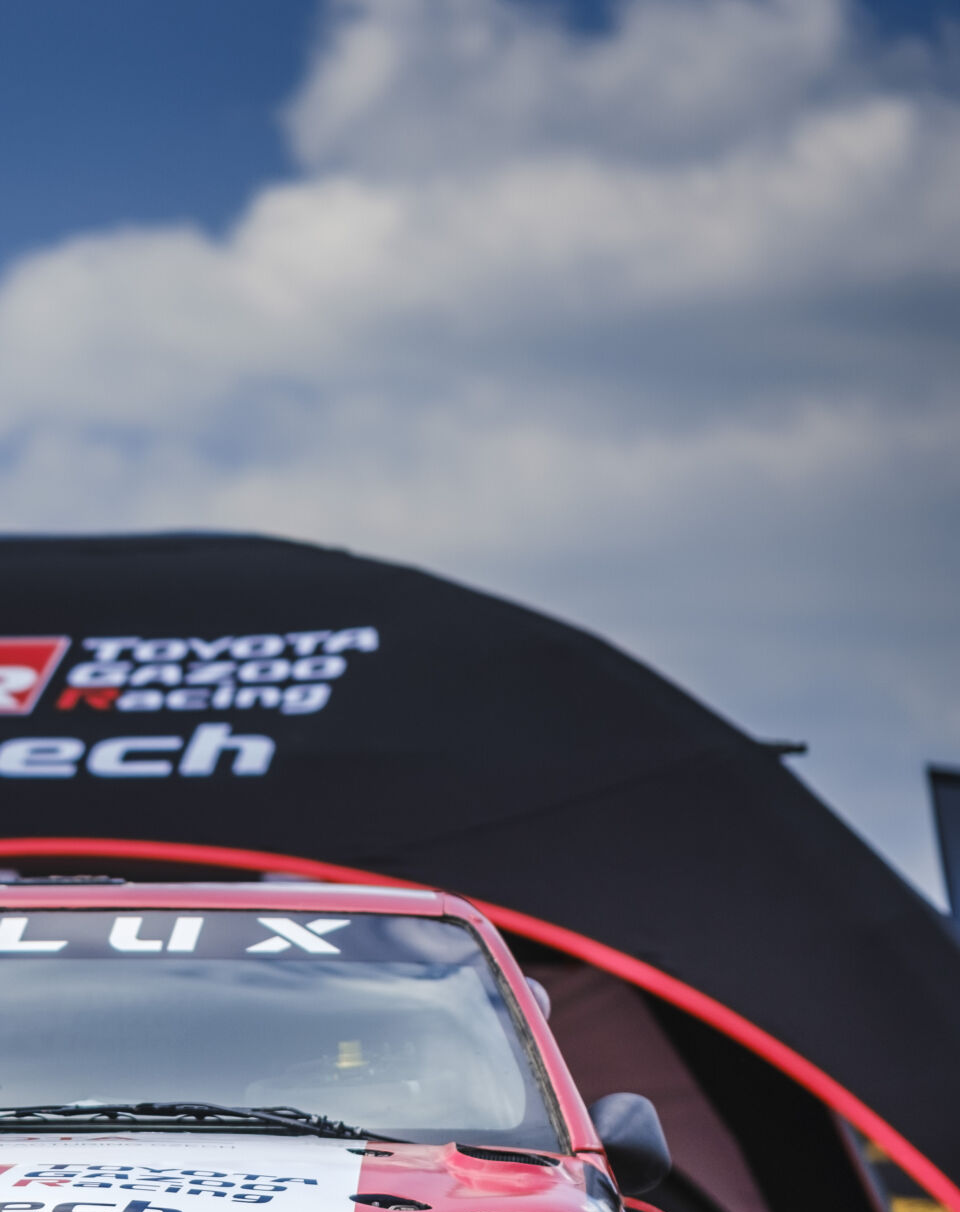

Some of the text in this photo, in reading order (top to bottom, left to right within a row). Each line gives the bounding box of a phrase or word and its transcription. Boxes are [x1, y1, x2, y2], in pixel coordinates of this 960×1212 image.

[84, 627, 380, 661] TOYOTA
[68, 656, 346, 686] GAZOO
[57, 682, 332, 715] Racing
[24, 1171, 288, 1192] GAZOO
[34, 1163, 318, 1185] TOYOTA
[12, 1179, 274, 1203] Racing
